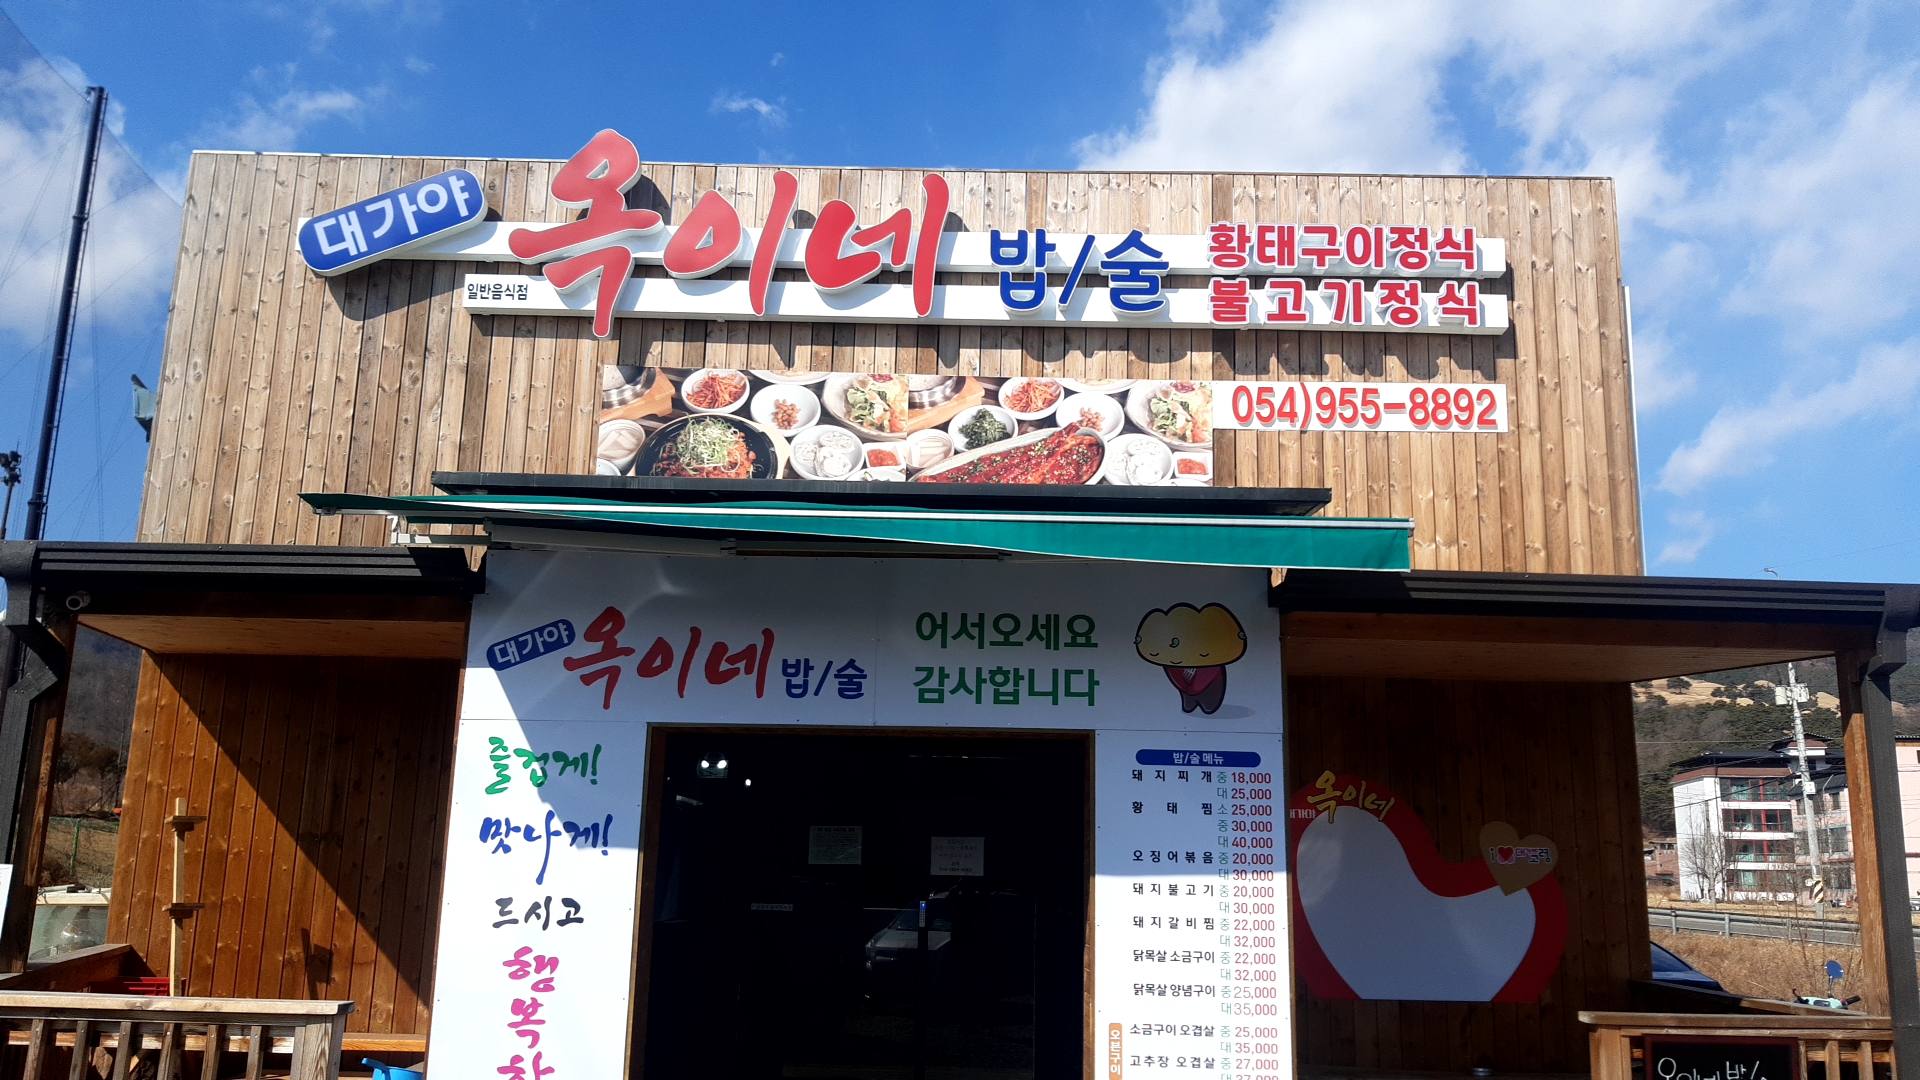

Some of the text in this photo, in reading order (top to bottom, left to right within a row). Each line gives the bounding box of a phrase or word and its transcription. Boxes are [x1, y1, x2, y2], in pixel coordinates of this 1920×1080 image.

[313, 129, 1170, 338] 대가야 옥이네 밥/술
[1208, 223, 1477, 273] 황태구이정식
[466, 281, 529, 302] 일반음식점
[1208, 277, 1480, 328] 불고기정식
[1231, 381, 1498, 430] 054)955-8892
[915, 611, 1099, 650] 어서오세요
[493, 605, 868, 710] 대가야 옥이네 밥/술
[913, 666, 1100, 706] 감사합니다
[485, 736, 602, 795] 즐겁게!
[1172, 752, 1224, 765] 밥/술 메뉴
[1216, 771, 1228, 784] 중
[1231, 772, 1272, 785] 18,000
[1216, 787, 1272, 801] 대 25,000
[1307, 769, 1396, 824] 옥이네
[1217, 804, 1228, 815] 소
[1231, 804, 1272, 818] 25,000
[1217, 820, 1273, 834] 중 30,000
[479, 810, 613, 885] 맛나게!
[1217, 836, 1273, 850] 대 40,000
[1218, 852, 1229, 865] 중
[1232, 853, 1274, 866] 20,000
[1218, 868, 1274, 883] 대 30,000
[1219, 885, 1230, 898] 중
[1233, 886, 1275, 899] 20,000
[492, 895, 585, 931] 드시고
[1219, 901, 1275, 915] 대 30,000
[1219, 918, 1230, 931] 중
[1233, 919, 1275, 932] 22,000
[1219, 935, 1276, 949] 대 32,000
[1133, 949, 1276, 966] 닭목살 소금구이 중 22,000
[1220, 969, 1277, 983] 대 32,000
[1133, 983, 1277, 1000] 닭목살 양념구이 중 25,000
[1221, 1002, 1278, 1017] 대 35,000
[1129, 1023, 1278, 1040] 소금구이 오겹살 중 25,000
[1109, 1029, 1122, 1076] 오븐구이
[1220, 1042, 1279, 1056] 대 35,000
[1130, 1055, 1279, 1072] 고추장 오겹살 중 27,000
